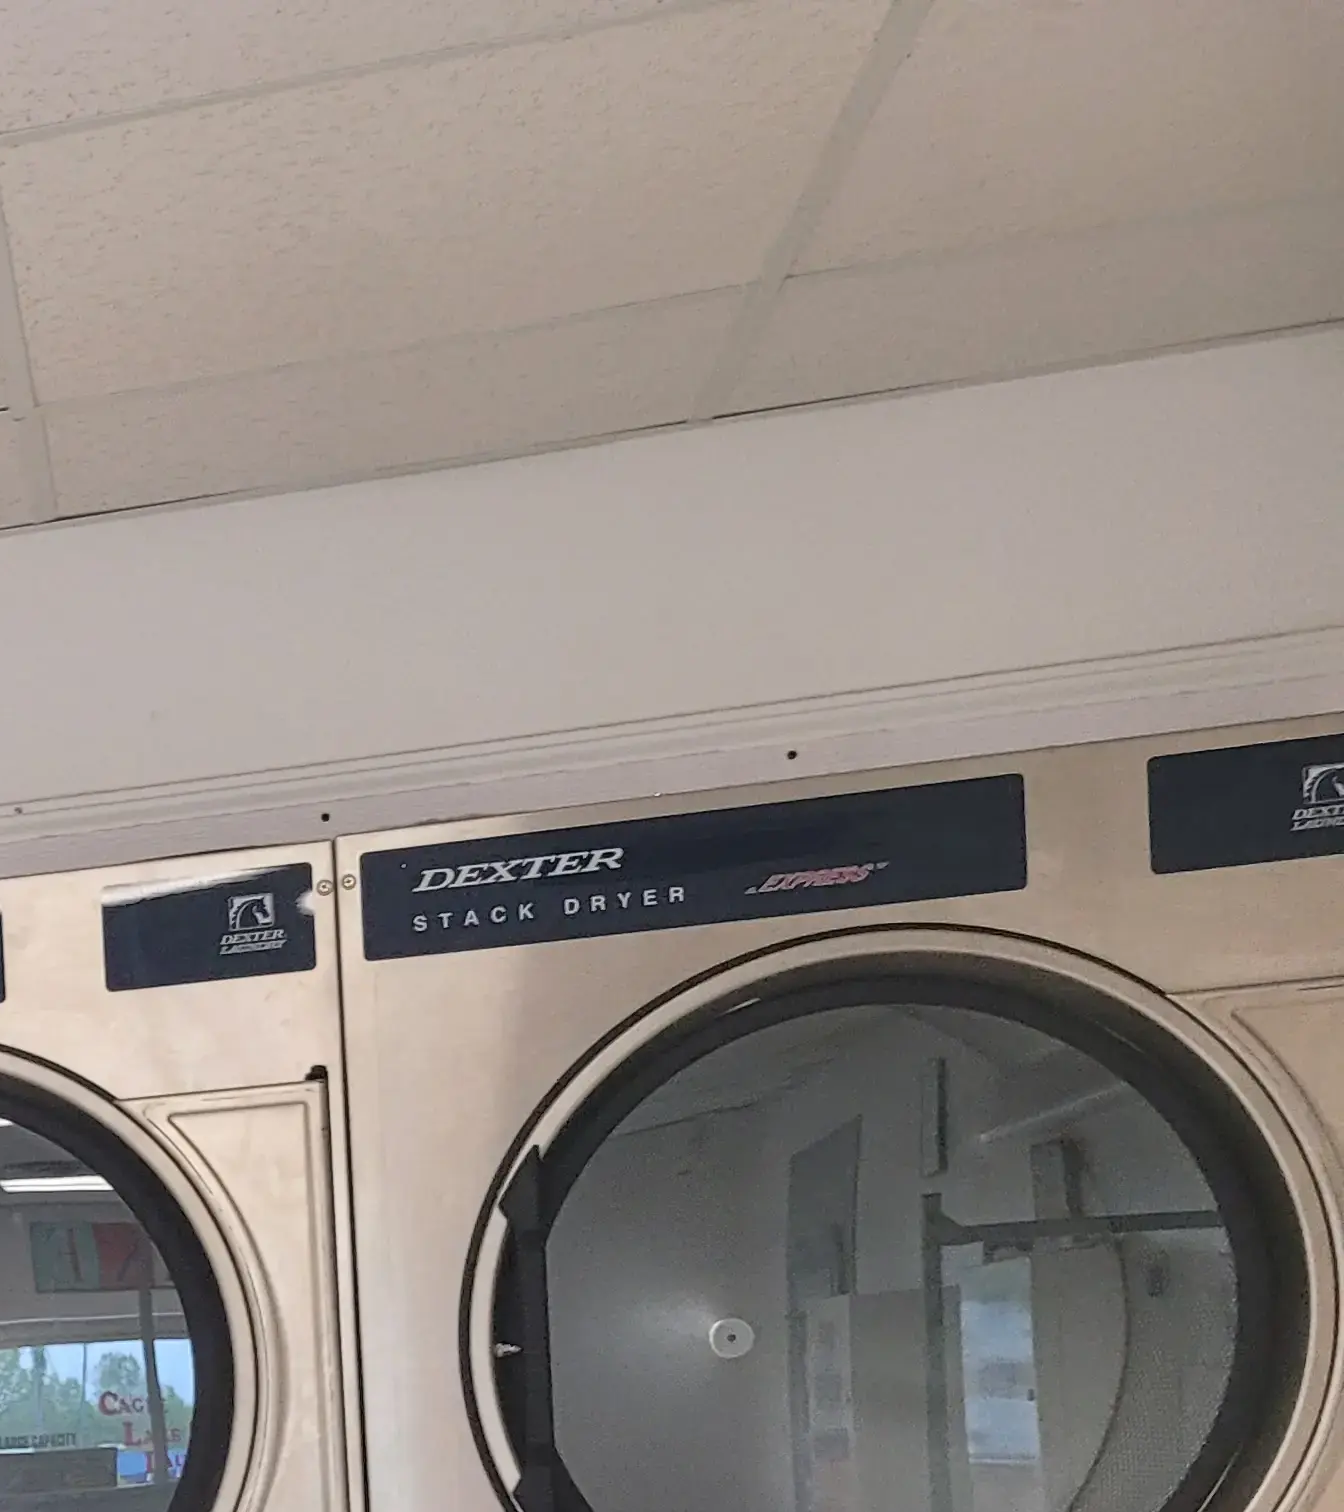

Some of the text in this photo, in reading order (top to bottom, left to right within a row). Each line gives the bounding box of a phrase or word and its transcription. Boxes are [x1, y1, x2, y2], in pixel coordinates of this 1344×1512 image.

[412, 848, 626, 892] DEXTER
[756, 862, 874, 894] EXPRESS
[413, 886, 687, 932] STACK DRYER
[220, 929, 286, 945] DEXTER
